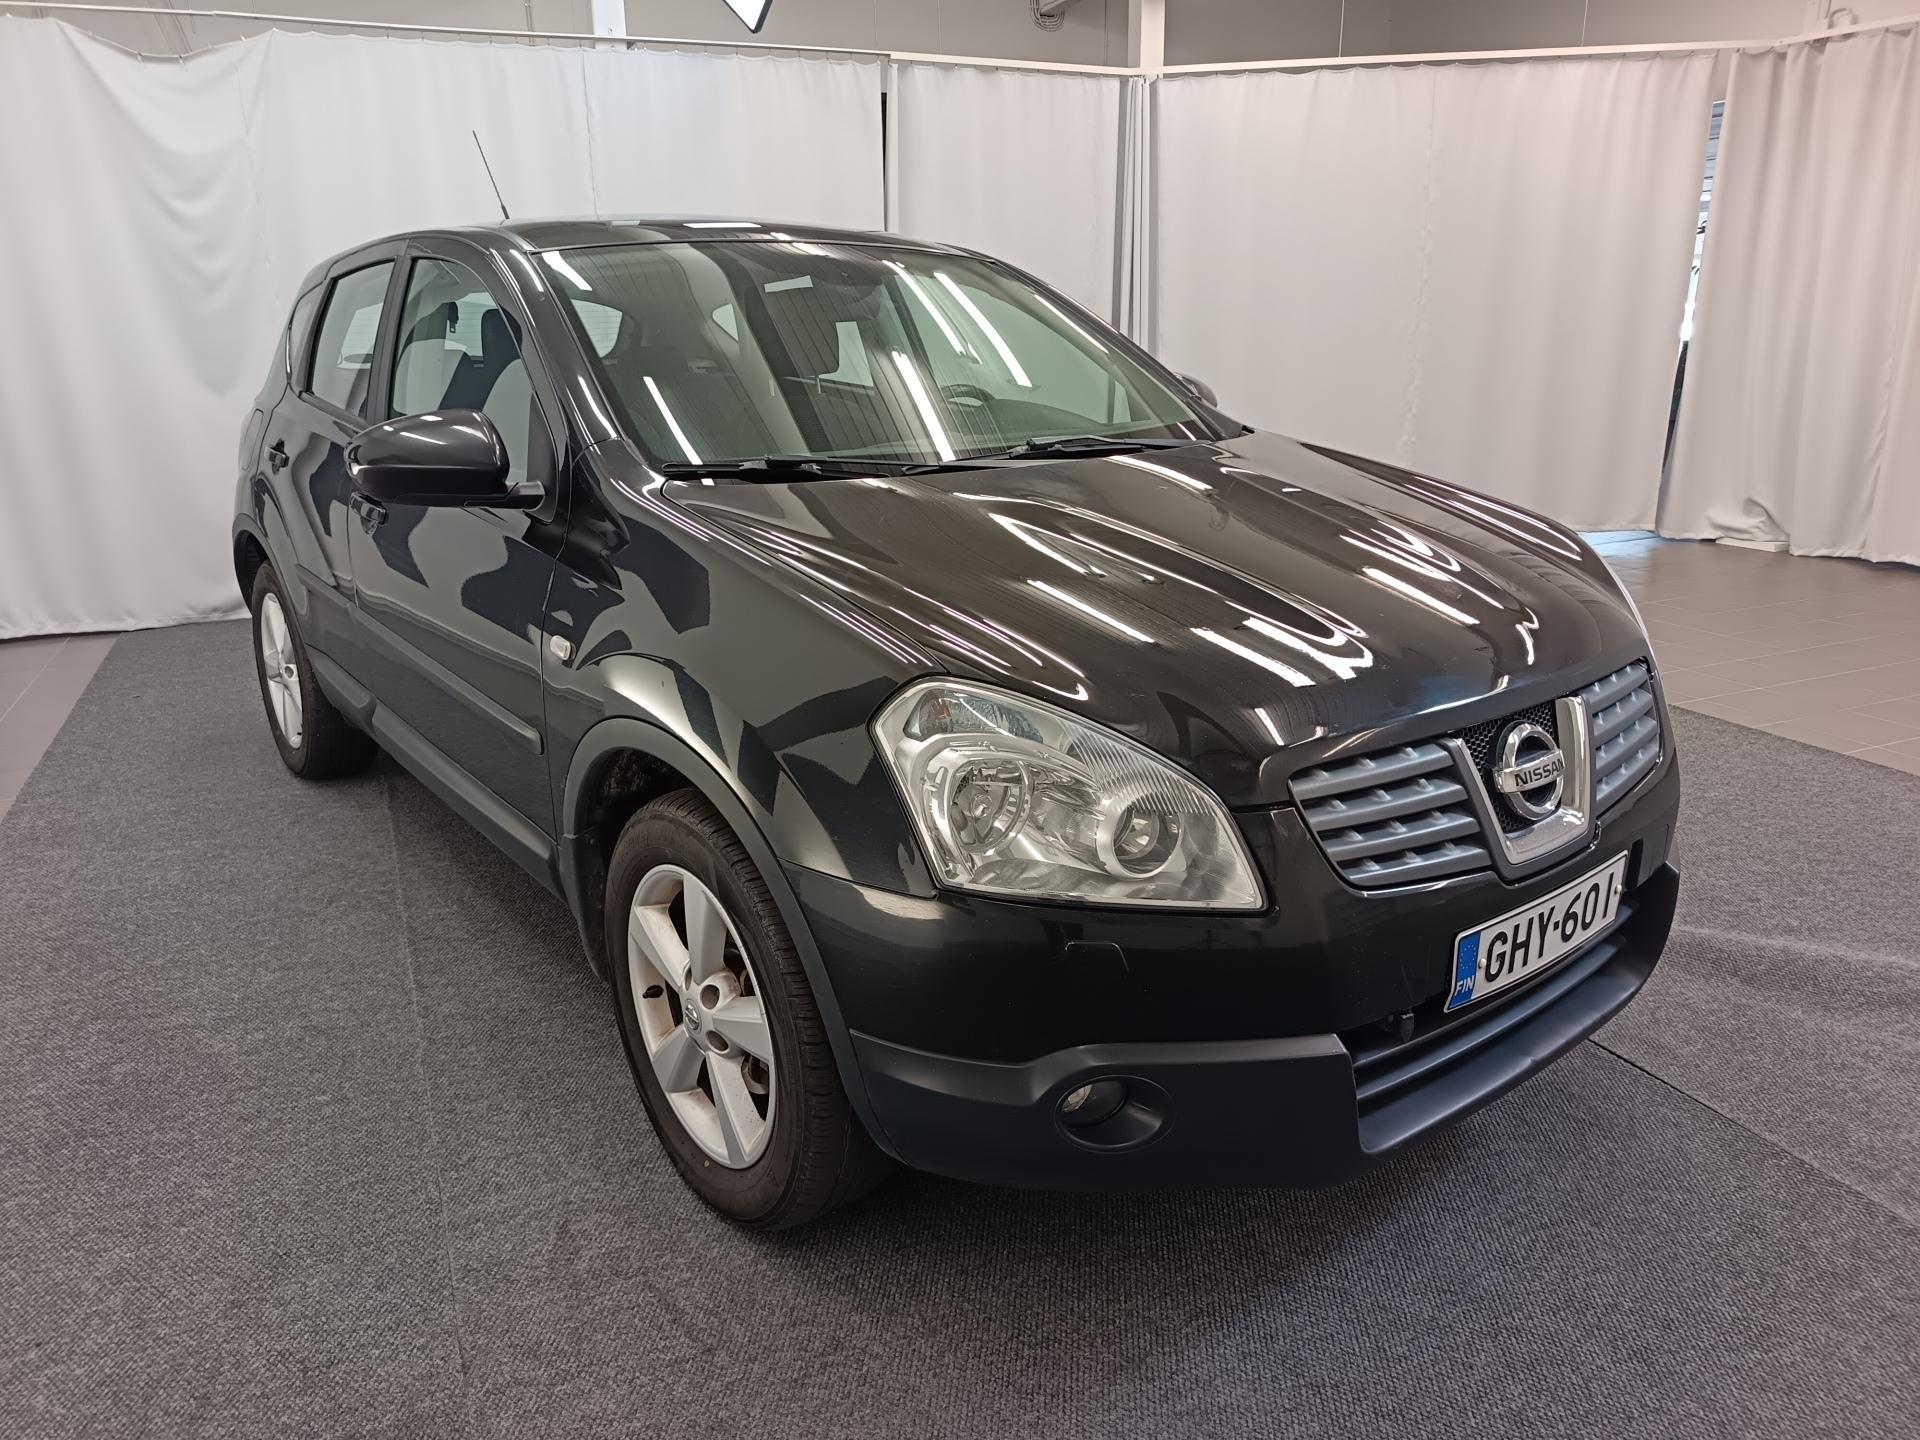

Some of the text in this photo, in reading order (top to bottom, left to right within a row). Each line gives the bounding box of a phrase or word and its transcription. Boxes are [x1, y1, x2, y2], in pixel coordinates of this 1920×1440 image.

[1514, 758, 1564, 787] NISSAN
[1485, 872, 1614, 983] GHY-601
[1454, 974, 1475, 997] FIN
